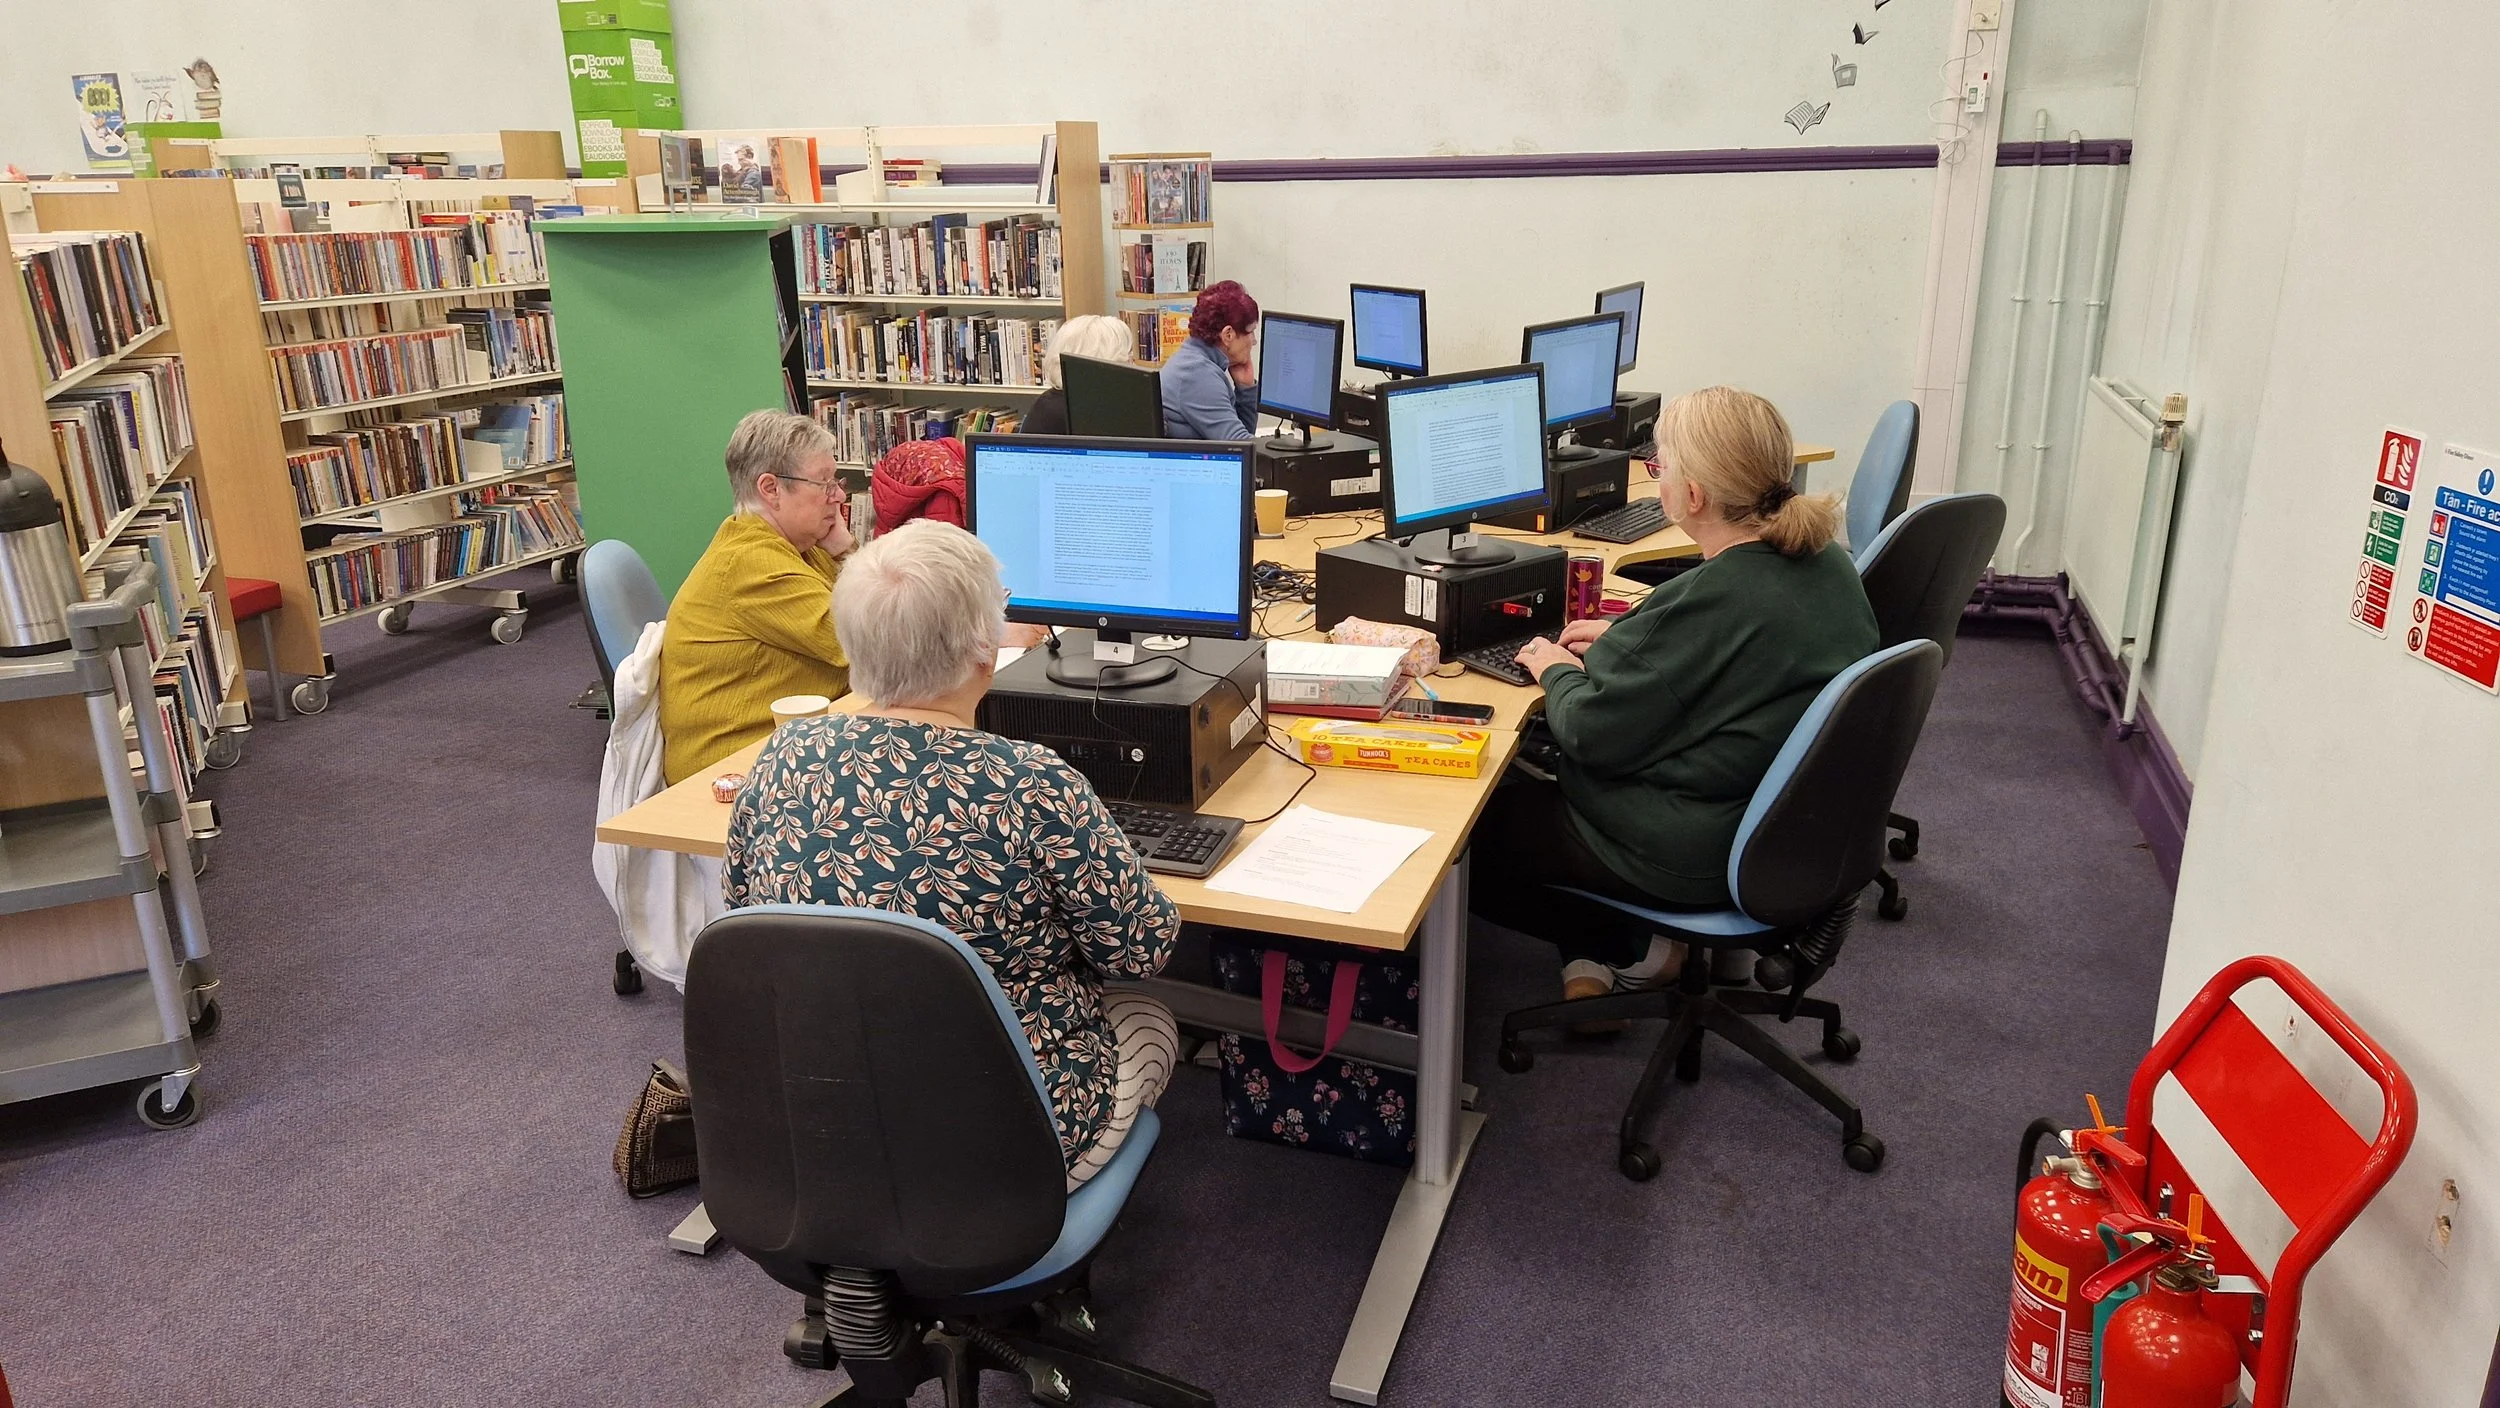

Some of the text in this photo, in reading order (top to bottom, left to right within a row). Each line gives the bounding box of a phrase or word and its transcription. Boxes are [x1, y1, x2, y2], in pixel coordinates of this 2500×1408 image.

[588, 54, 625, 67] Borrow
[590, 67, 613, 80] Box.
[585, 152, 626, 161] EAUDIOBOO
[883, 256, 893, 277] 1918
[980, 334, 988, 354] WALL
[1163, 336, 1185, 345] Anywa
[2443, 492, 2460, 509] Tân
[2466, 499, 2487, 518] Fire
[1113, 646, 1119, 654] 4
[1331, 735, 1366, 745] TEA
[1371, 738, 1429, 749] CAKES
[1359, 748, 1390, 759] TUNNOCK'S
[1405, 756, 1430, 766] TEA
[1433, 758, 1472, 769] CAKES
[2015, 1250, 2064, 1297] am
